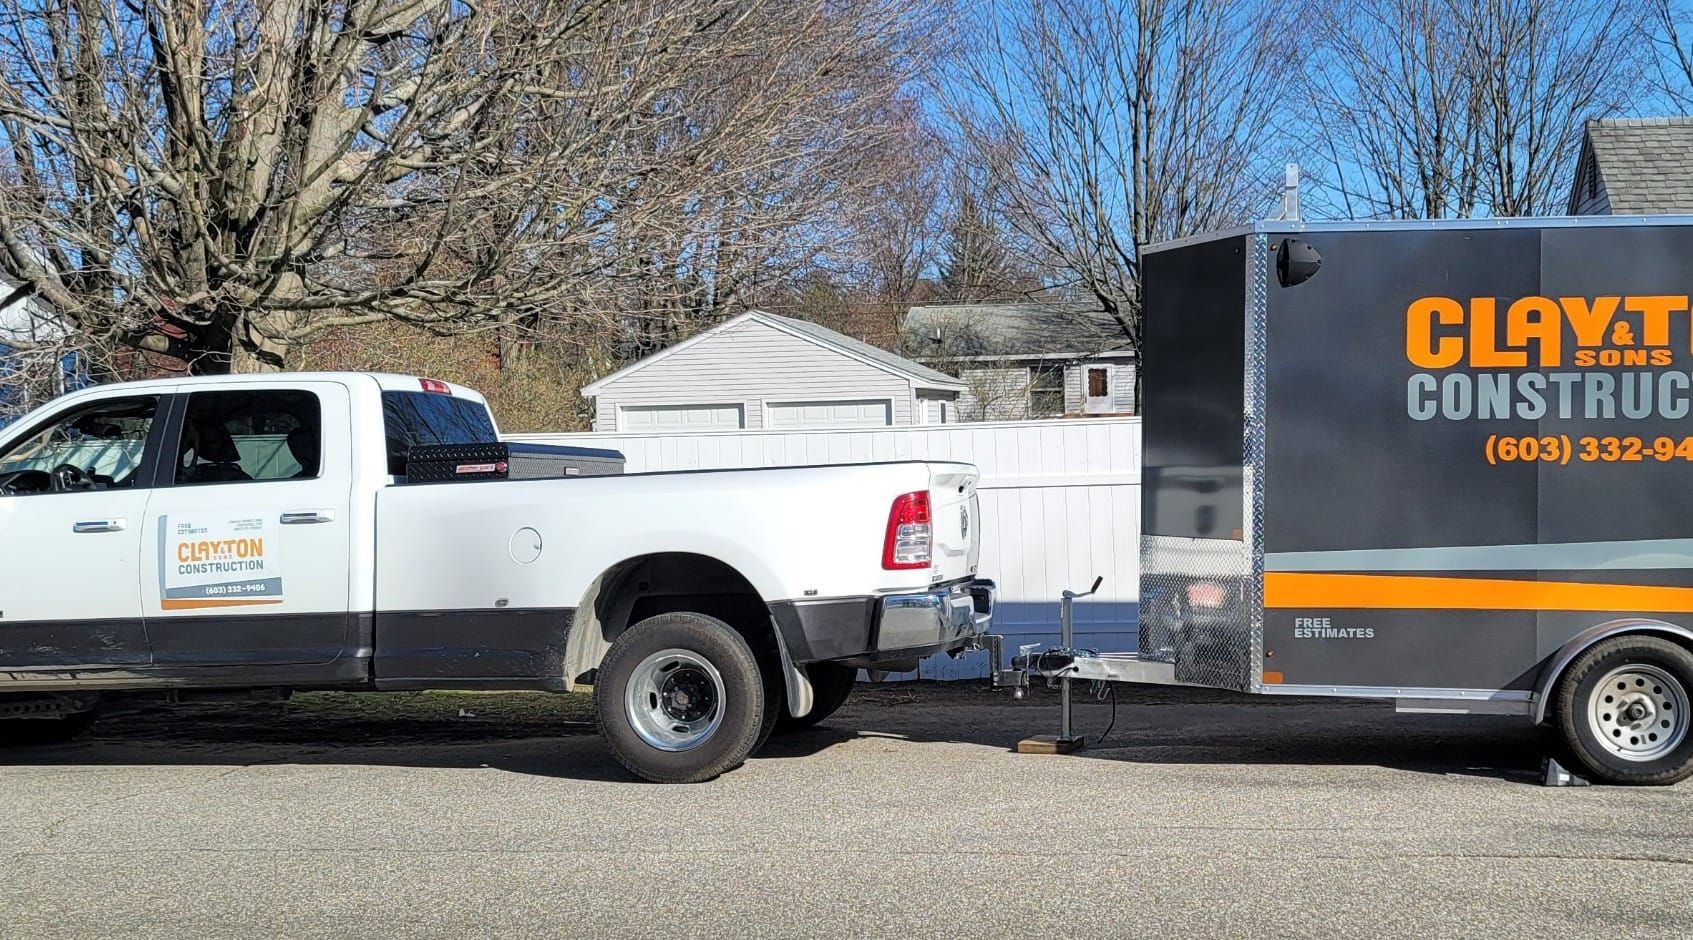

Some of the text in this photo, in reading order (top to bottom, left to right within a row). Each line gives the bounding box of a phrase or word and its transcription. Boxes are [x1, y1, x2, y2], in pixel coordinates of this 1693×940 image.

[1406, 295, 1693, 368] CLAYT
[1611, 320, 1635, 345] &
[1574, 349, 1672, 366] SONS
[1407, 371, 1693, 420] CONSTRUC
[1485, 434, 1572, 465] (603)
[178, 538, 263, 562] CLAYTON
[178, 560, 264, 574] CONSTRUCTION
[205, 584, 266, 595] (603) 332-9406
[1295, 618, 1331, 628] FREE
[1295, 628, 1374, 638] ESTIMATES
